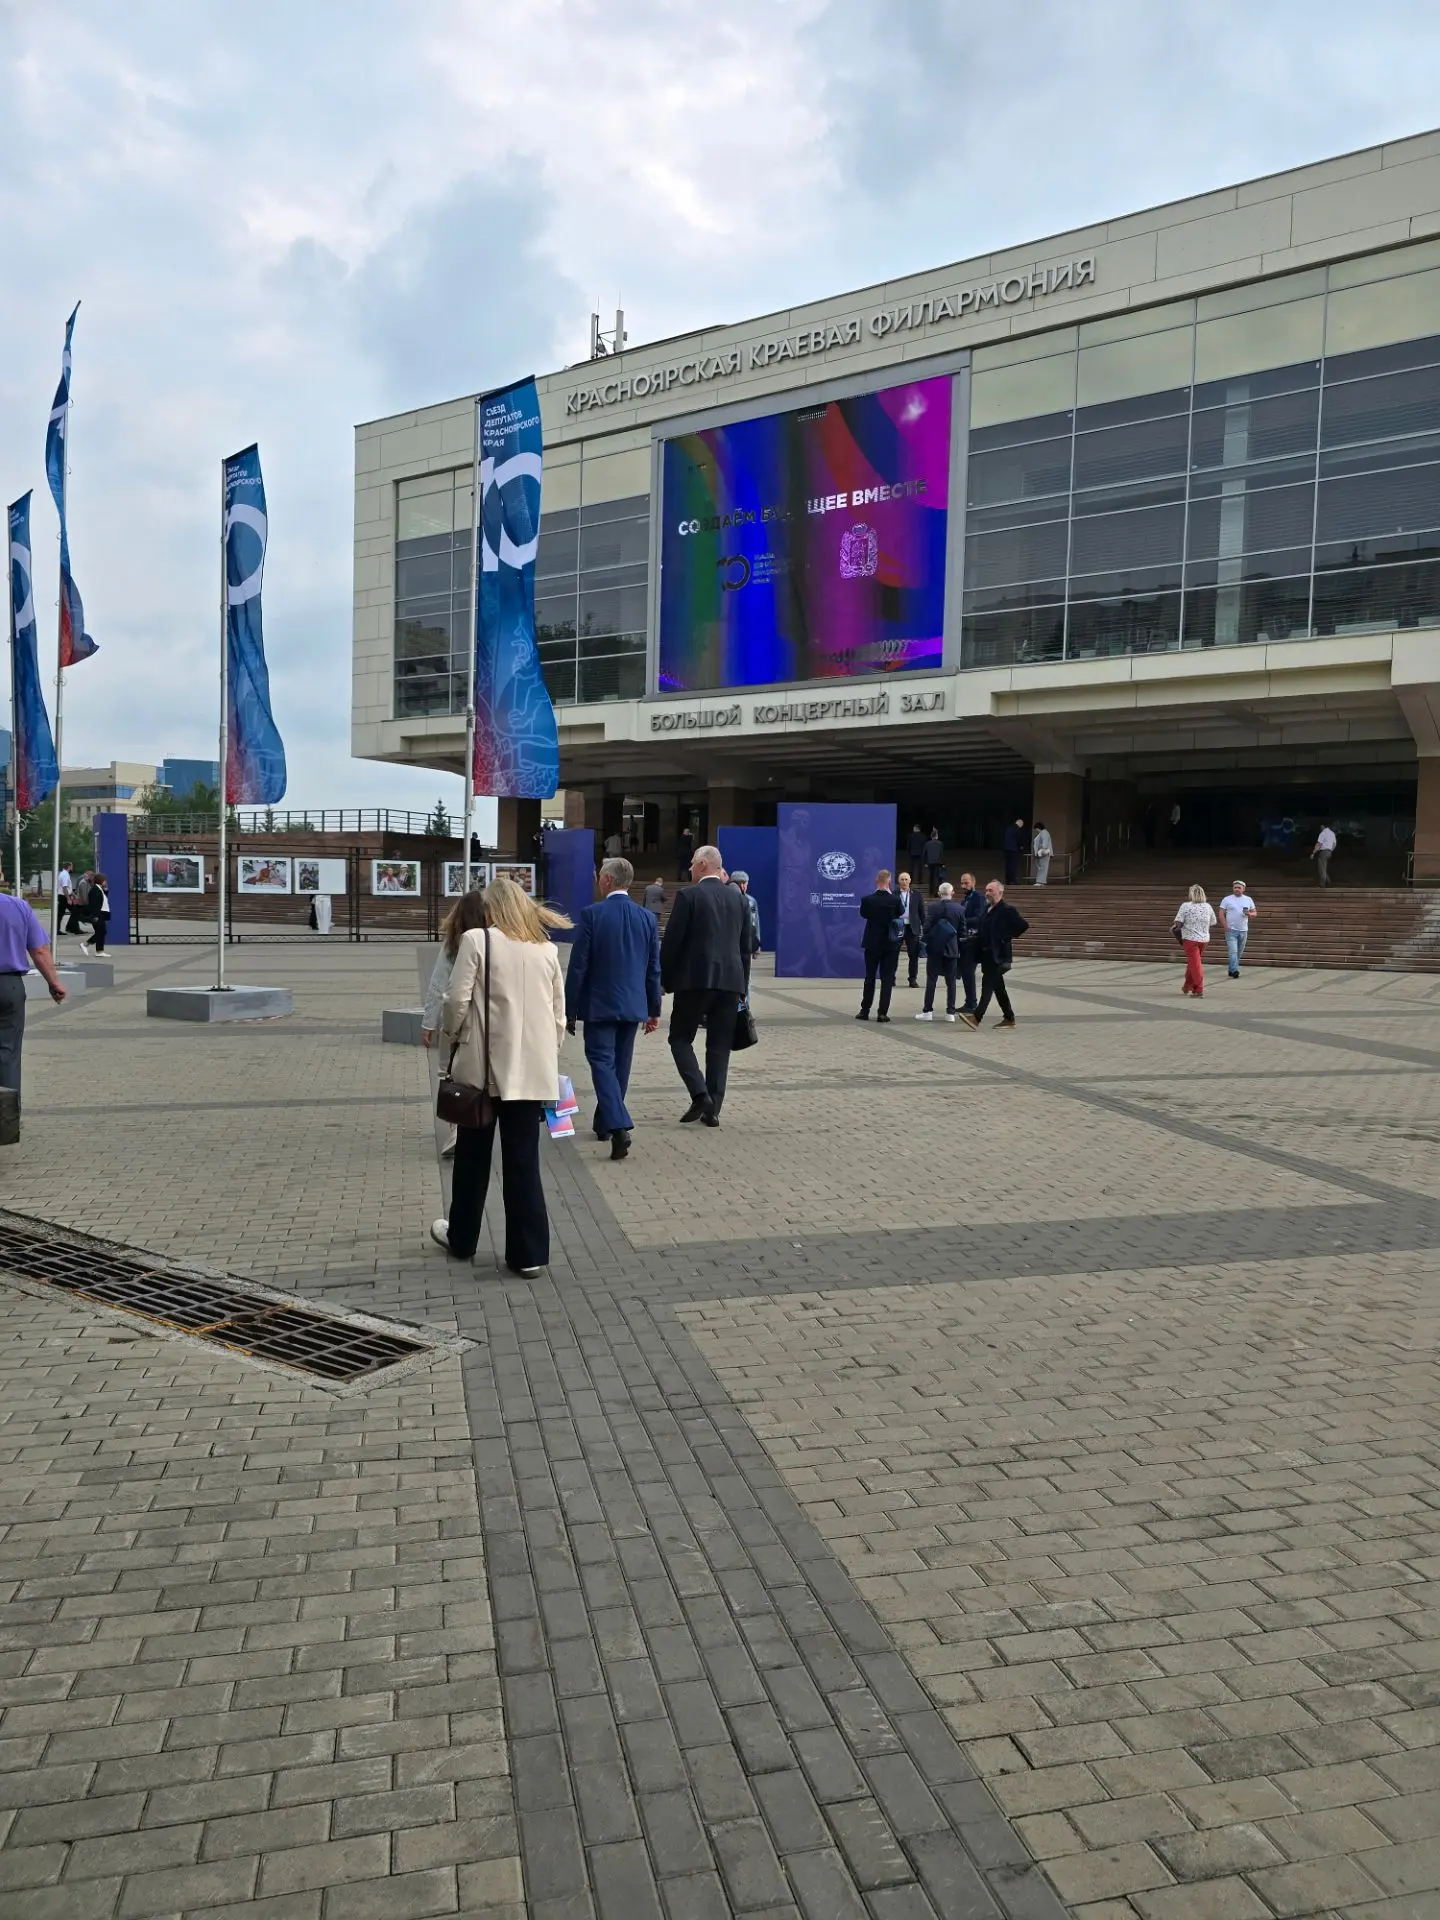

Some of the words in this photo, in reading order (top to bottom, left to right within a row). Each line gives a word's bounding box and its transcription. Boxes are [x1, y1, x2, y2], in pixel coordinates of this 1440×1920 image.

[563, 349, 742, 416] КРАСНОЯРСКАЯ
[749, 317, 863, 370] КРАЕВАЯ
[868, 254, 1096, 340] ФИЛАРМОНИЯ
[484, 410, 523, 428] ДЕПУТАТОВ
[486, 404, 506, 417] СЪЕЗД
[483, 416, 540, 437] КРАСНОЯРСКОГО
[483, 438, 505, 447] КРАЯ
[852, 479, 928, 506] ВМЕСТЕ
[651, 704, 742, 732] БОЛЬШОЙ
[753, 692, 890, 725] КОНЦЕРТНЫЙ
[901, 691, 945, 713] ЗАЛ
